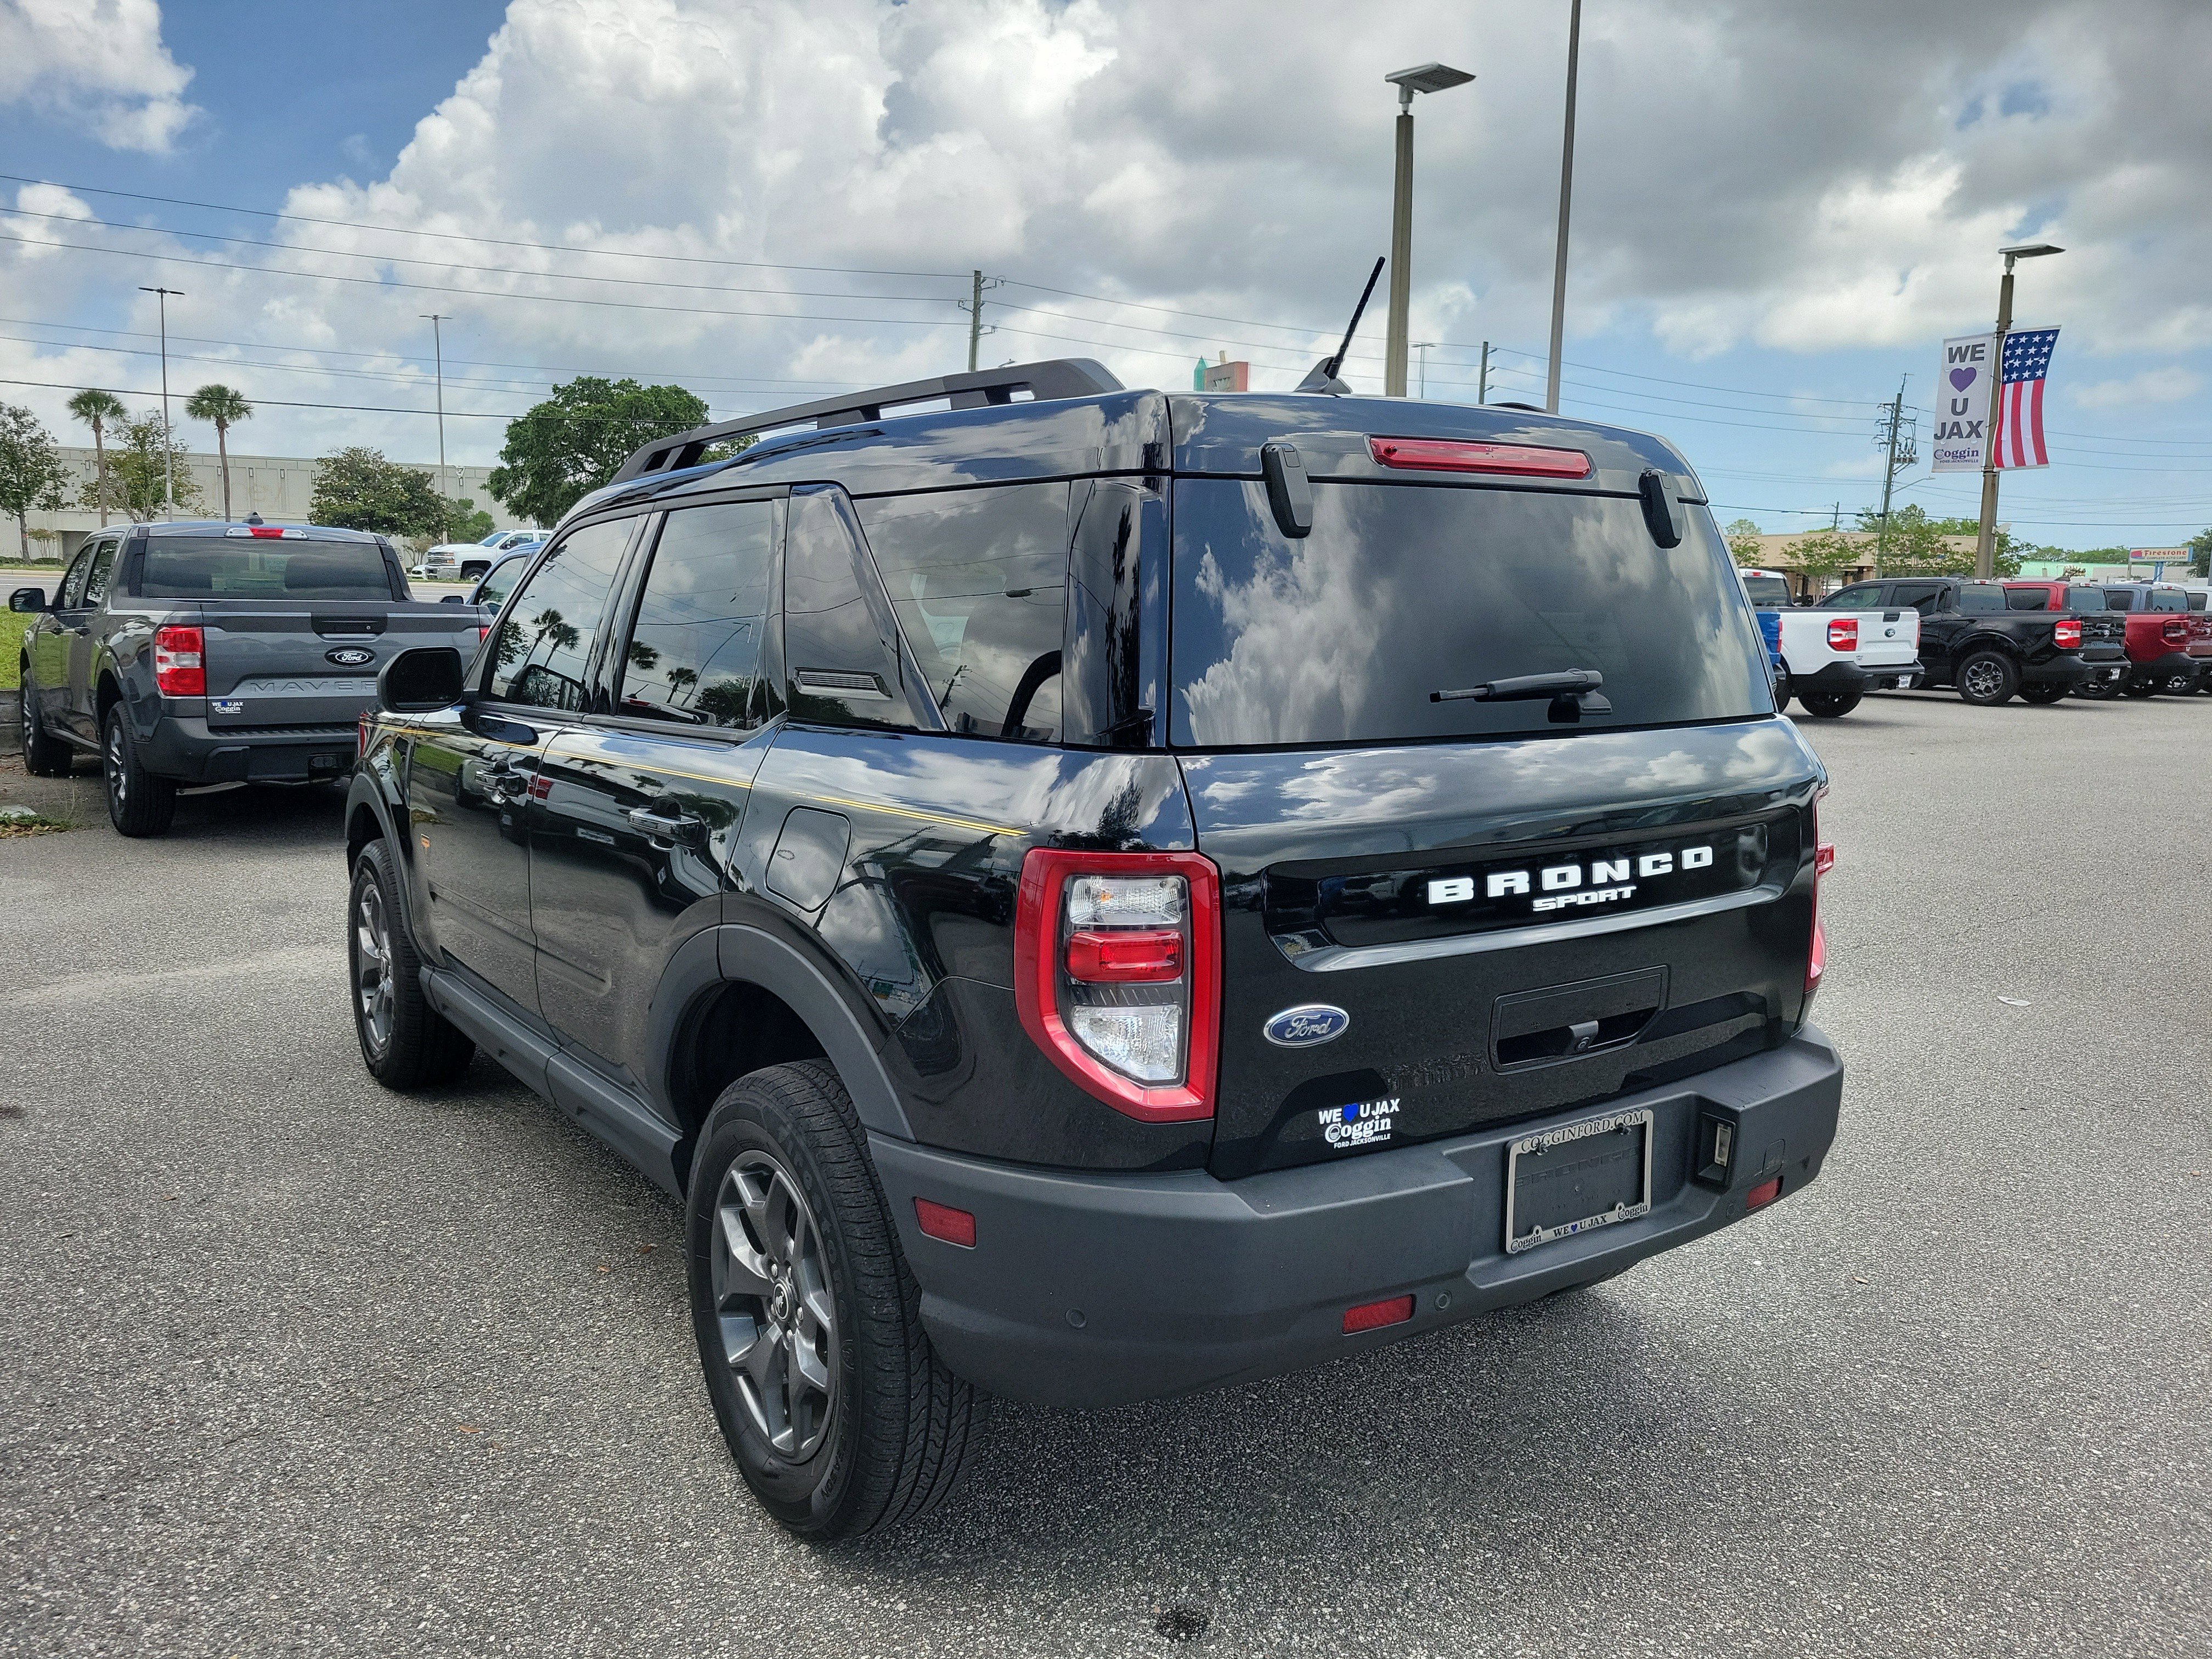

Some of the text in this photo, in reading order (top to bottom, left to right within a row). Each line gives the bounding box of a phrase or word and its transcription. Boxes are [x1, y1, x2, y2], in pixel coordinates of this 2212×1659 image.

[1948, 343, 1986, 363] WE
[1951, 398, 1968, 416] U
[1934, 420, 1984, 440] JAX
[1934, 447, 1979, 460] Coggin
[341, 652, 362, 662] Ford
[250, 680, 378, 692] MAVER
[1428, 847, 1713, 905] BRONCO
[1532, 886, 1637, 912] SPORT
[1284, 1014, 1332, 1039] Ford
[1318, 1098, 1400, 1124] WE U JAX
[1325, 1115, 1391, 1143] Coggin
[1521, 1111, 1644, 1152] COGGINFORD.COM
[1334, 1133, 1391, 1149] FORD JACKSONVILLE
[1511, 1205, 1648, 1251] Coggin WE U JAX Coggin
